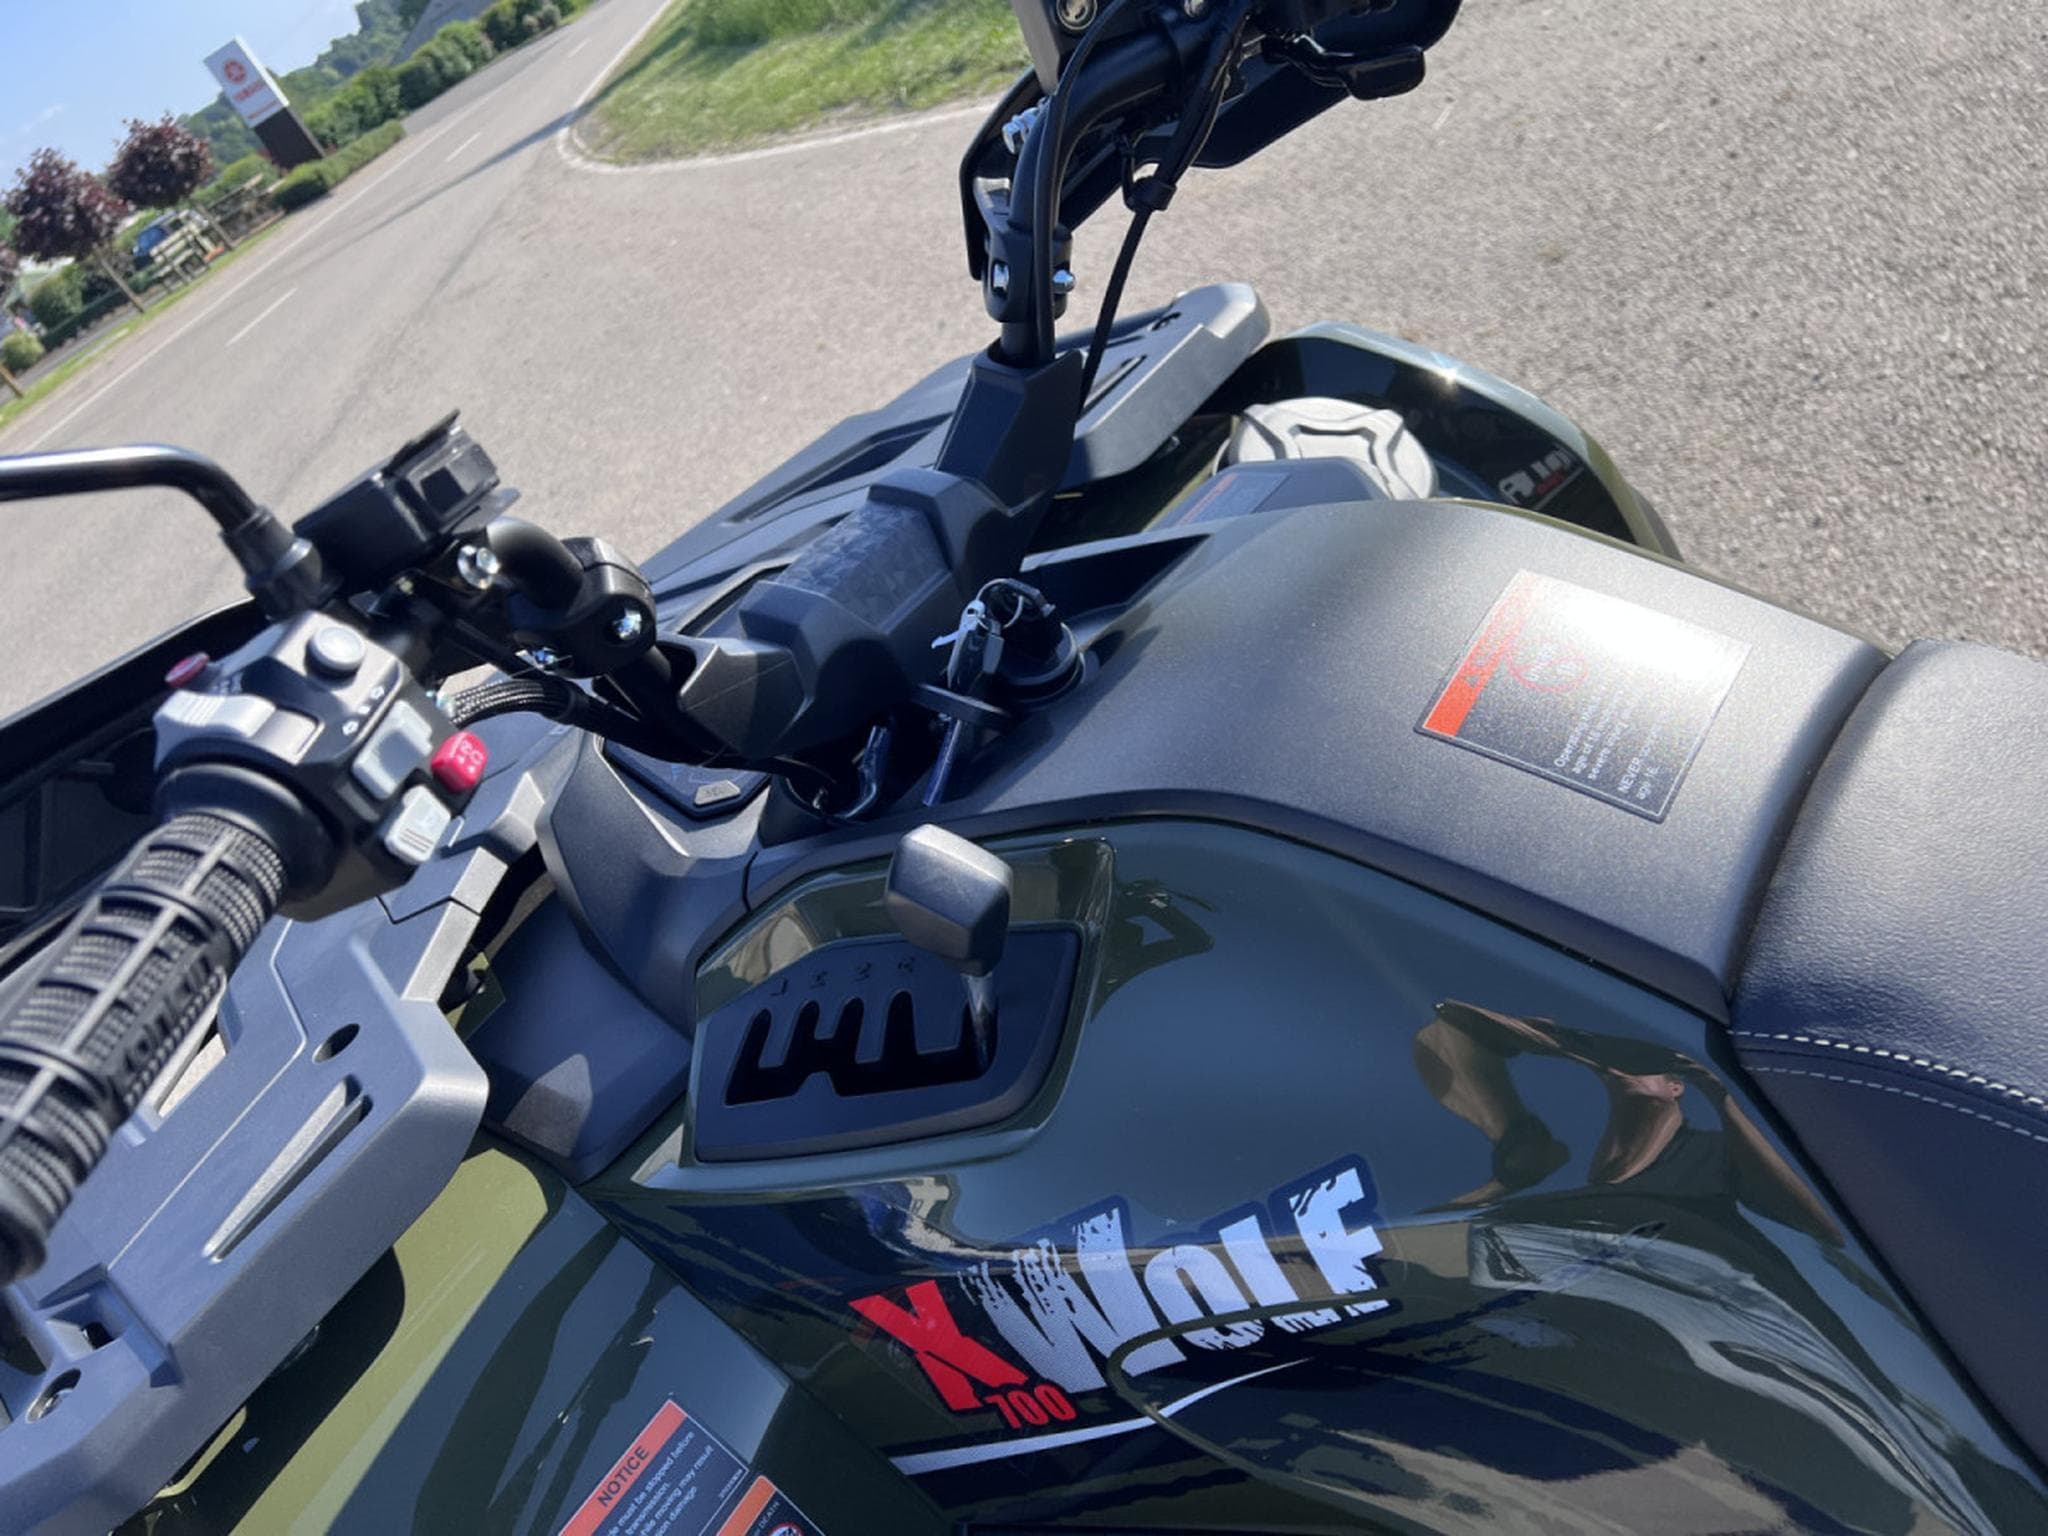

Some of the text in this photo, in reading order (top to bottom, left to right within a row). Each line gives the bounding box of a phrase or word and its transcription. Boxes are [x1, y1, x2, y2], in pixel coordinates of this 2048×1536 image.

[1617, 756, 1643, 793] NEVER
[984, 1384, 1077, 1429] 700
[597, 1445, 649, 1507] NOTICE
[618, 1503, 638, 1526] must
[634, 1490, 647, 1504] be
[645, 1457, 674, 1492] stopped
[654, 1487, 682, 1520] moving
[679, 1469, 696, 1489] may
